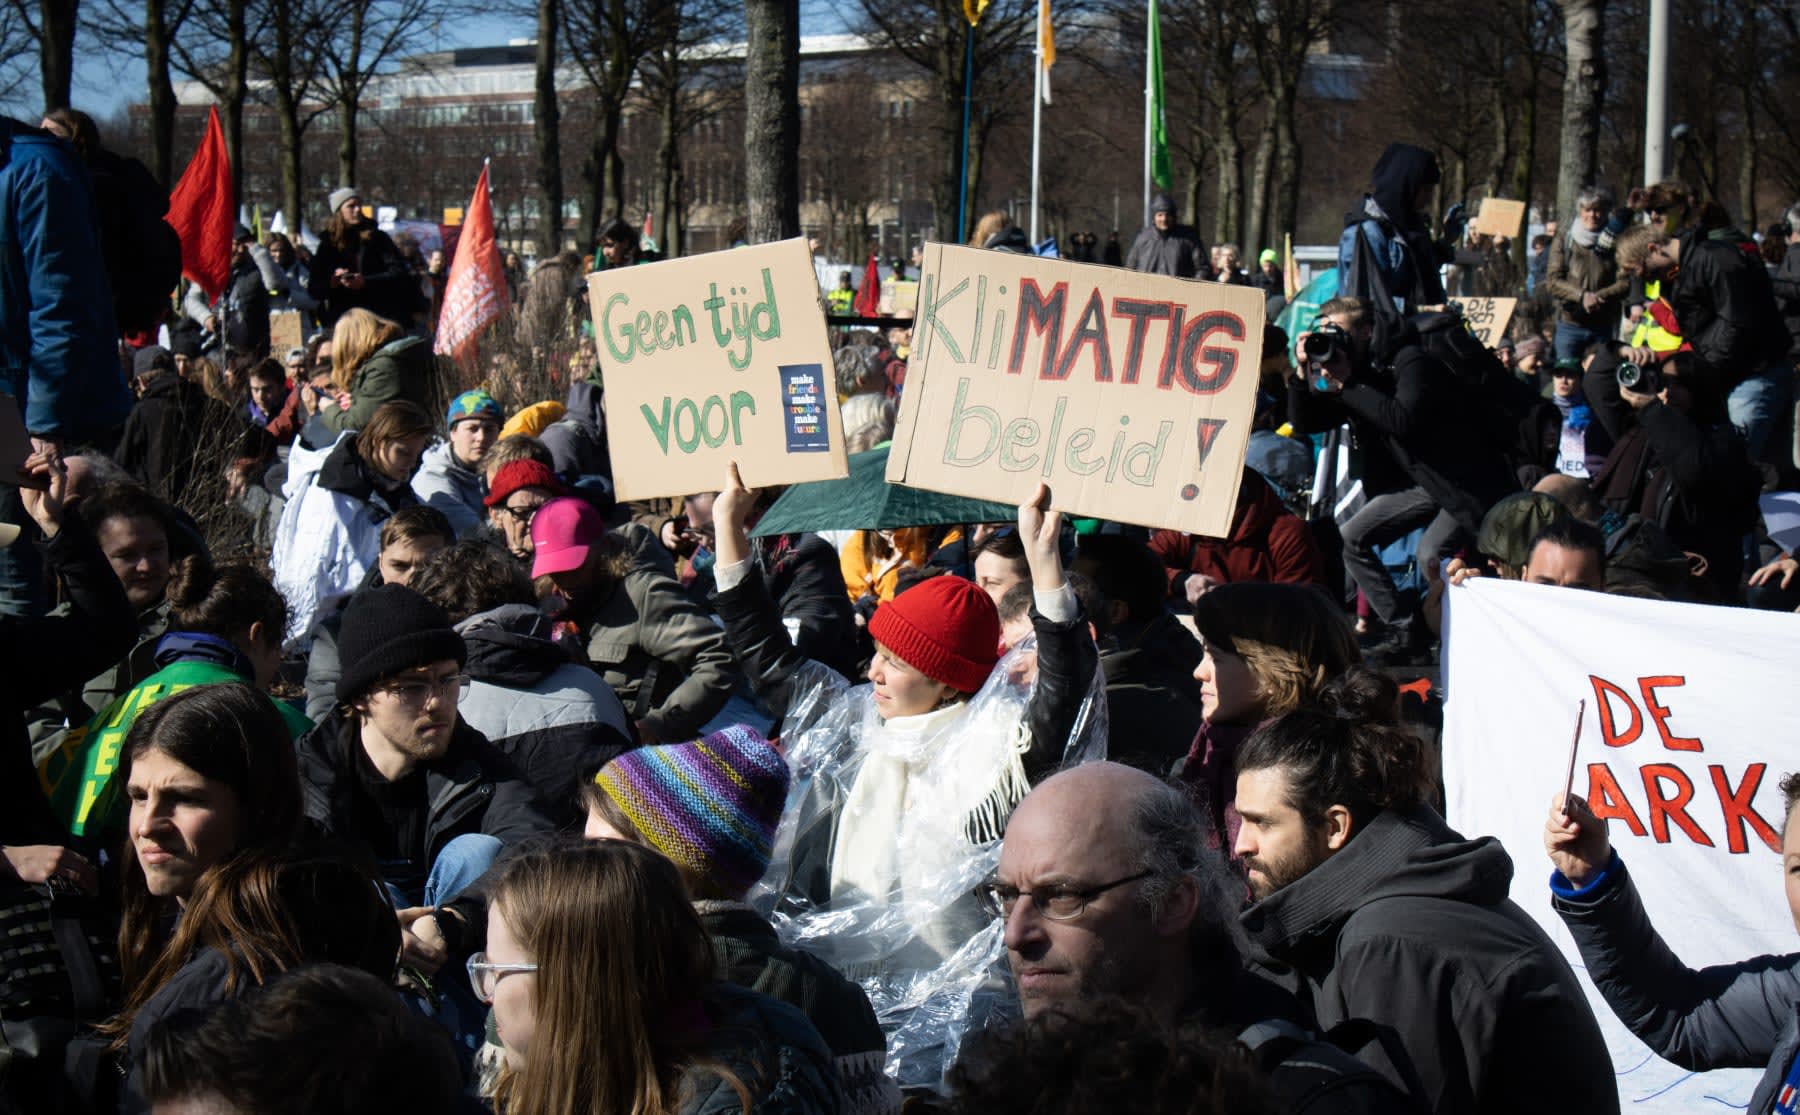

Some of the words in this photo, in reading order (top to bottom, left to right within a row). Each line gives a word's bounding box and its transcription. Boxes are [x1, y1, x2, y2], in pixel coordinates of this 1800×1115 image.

[602, 292, 697, 363] Geen
[703, 267, 781, 371] tijd
[917, 273, 1246, 396] KliMATIG
[788, 384, 819, 394] friends
[790, 374, 814, 384] make
[790, 404, 821, 414] trouble
[792, 394, 816, 404] make
[639, 391, 756, 456] voor
[794, 414, 818, 424] make
[1588, 674, 1704, 752] DE
[1587, 763, 1785, 854] ARK
